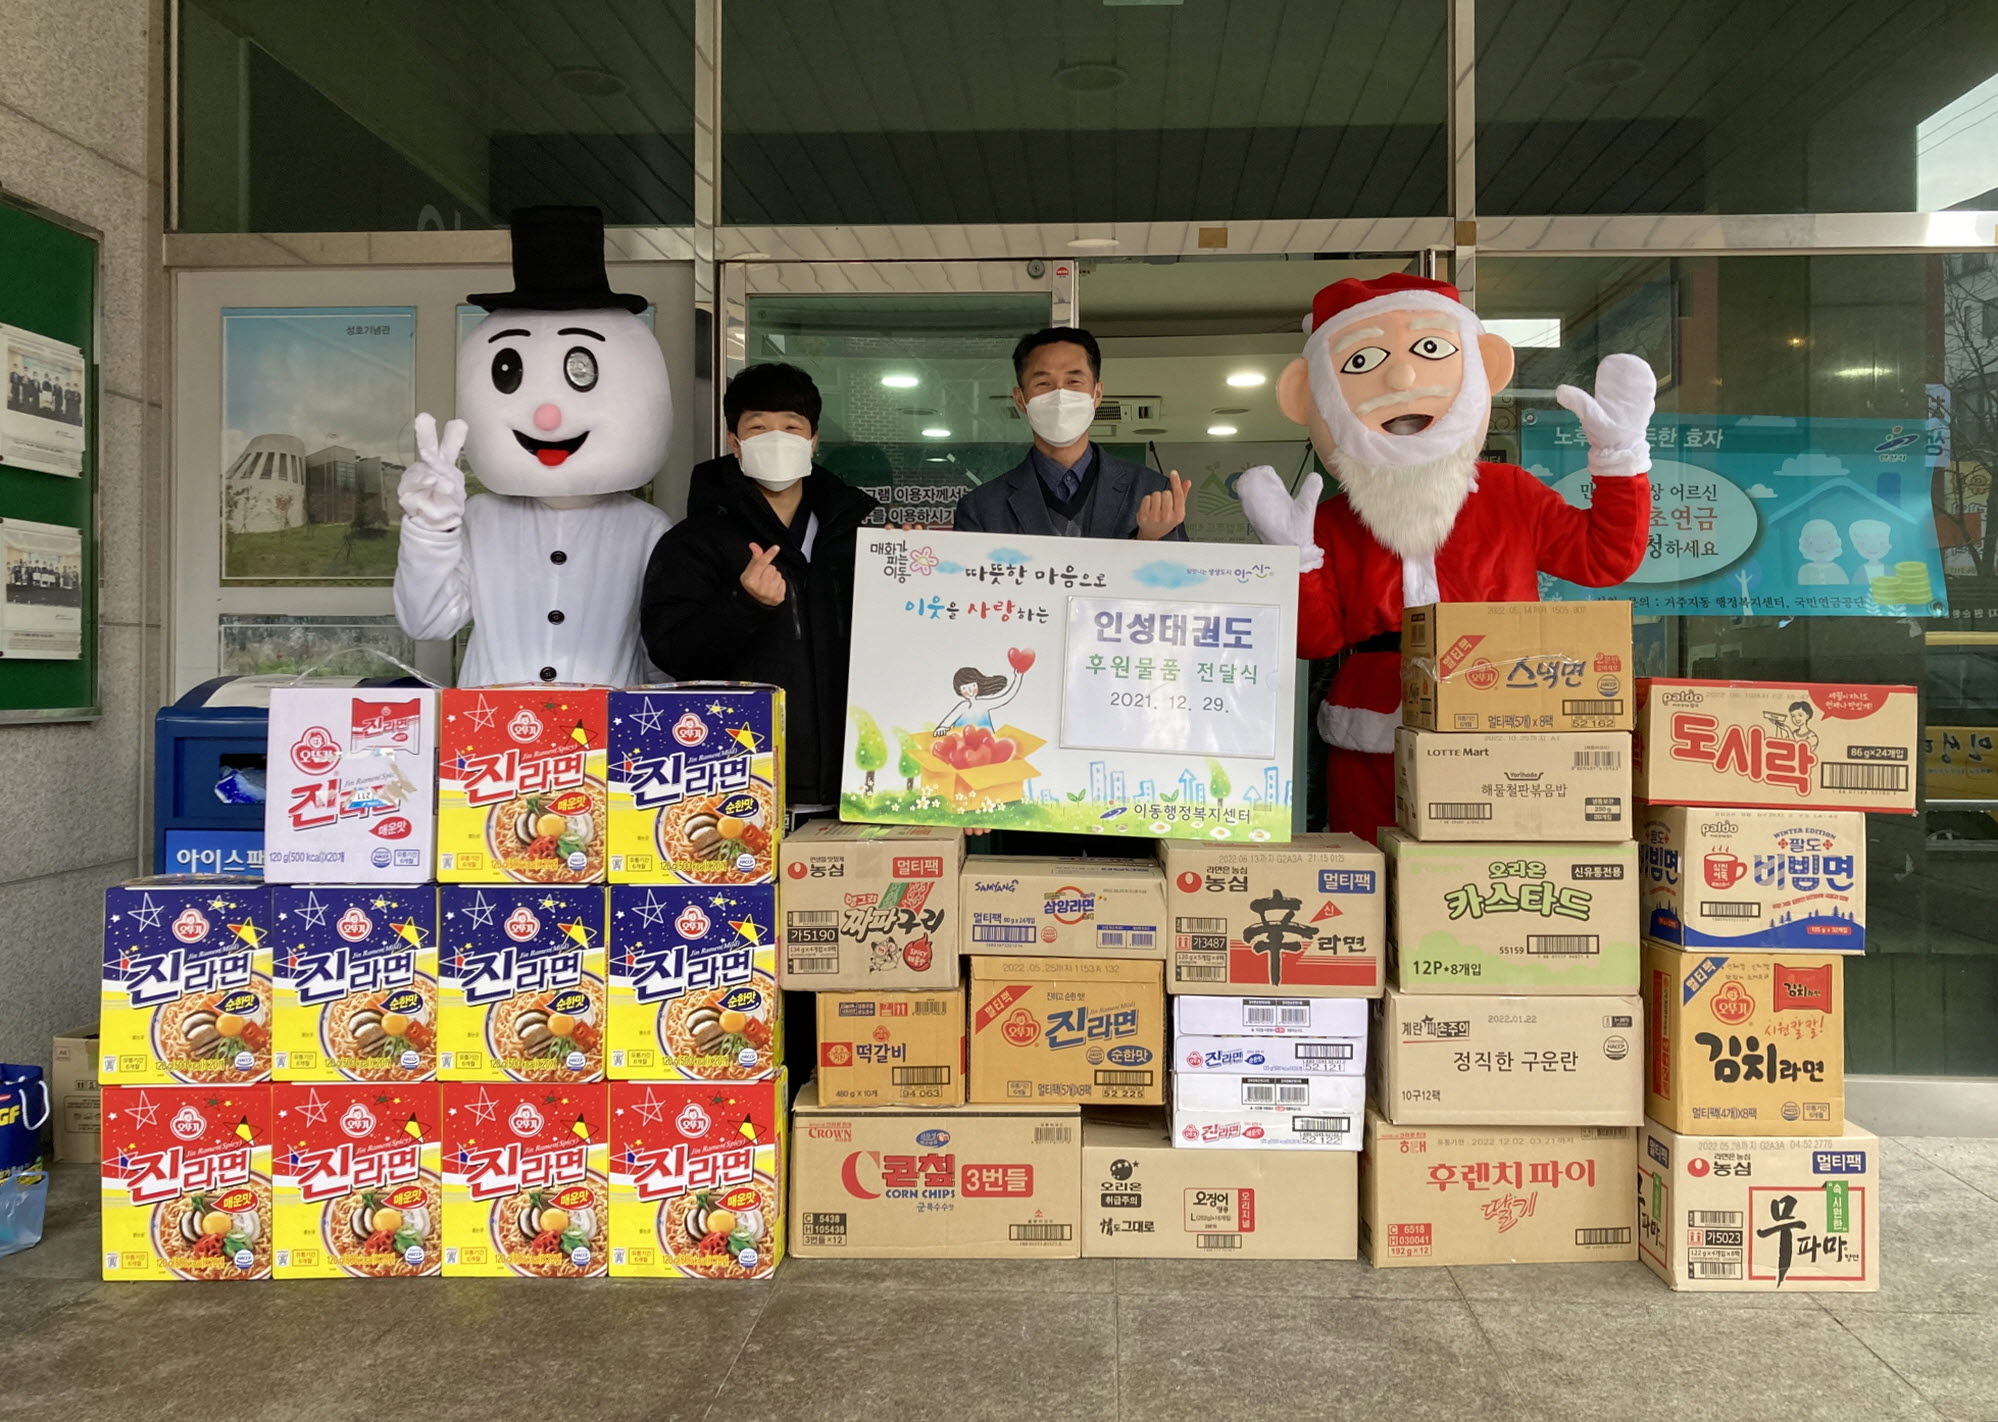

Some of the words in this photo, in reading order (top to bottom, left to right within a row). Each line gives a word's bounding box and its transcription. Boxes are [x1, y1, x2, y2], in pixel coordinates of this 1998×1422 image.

[346, 325, 391, 336] 성호기념관
[1684, 429, 1723, 449] 효자
[1670, 483, 1717, 501] 어르신
[870, 540, 908, 556] 매화가
[883, 566, 911, 583] 이동
[965, 563, 1028, 585] 따뜻한
[1035, 564, 1107, 588] 마음으로
[905, 595, 960, 619] 이웃을
[967, 599, 1049, 624] 사랑하는
[1094, 611, 1253, 649] 인성태권도
[1443, 638, 1472, 668] 멀티팩
[1086, 653, 1181, 682] 후원물품
[1197, 662, 1257, 685] 전달식
[1472, 671, 1494, 683] 오뚜기
[1506, 656, 1586, 689] 스낵면
[1110, 692, 1158, 709] 2021.
[1169, 695, 1192, 711] 12.
[1202, 697, 1229, 713] 29.
[1662, 689, 1703, 706] paldo
[363, 718, 409, 735] 진라면
[513, 725, 538, 734] 오뚜기
[1572, 720, 1587, 728] 52
[1592, 720, 1615, 728] 162
[679, 728, 701, 738] 오뚜기
[1427, 749, 1460, 757] LOTTE
[1462, 748, 1489, 757] Mart
[1671, 712, 1818, 796] 도시락
[465, 749, 584, 805] 진라면
[630, 752, 749, 808] 진라면
[1481, 784, 1567, 797] 해물철판볶음밥
[556, 796, 587, 811] 매운맛
[725, 799, 754, 814] 순한맛
[1134, 804, 1250, 824] 이동행정복지센터
[377, 821, 407, 836] 매운맛
[1701, 820, 1738, 837] paldo
[1773, 828, 1802, 839] WINTER
[1805, 827, 1836, 839] EDITION
[1789, 839, 1821, 852] 팔도
[810, 863, 844, 878] 농심
[897, 859, 939, 875] 멀티팩
[1207, 866, 1230, 874] 라면은
[1232, 866, 1247, 874] 농심
[1489, 861, 1546, 879] 오리온
[1574, 867, 1621, 878] 신유통전용
[1754, 854, 1853, 891] 비빔면
[975, 879, 1019, 893] SAMYANG
[1205, 876, 1248, 893] 농심
[1324, 873, 1370, 890] 멀티팩
[1044, 899, 1094, 914] 삼양라면
[1444, 881, 1592, 921] 카스타드
[1324, 906, 1334, 916] 신
[180, 924, 202, 934] 오뚜기
[344, 924, 366, 933] 오뚜기
[511, 923, 534, 933] 오뚜기
[682, 922, 705, 932] 오뚜기
[841, 906, 945, 943] 짜파구리
[791, 929, 836, 942] 가5190
[1243, 889, 1319, 986] 辛
[1194, 938, 1225, 950] 가3487
[1318, 935, 1366, 955] 라면
[128, 949, 251, 1007] 진라면
[295, 948, 413, 1006] 진라면
[461, 947, 582, 1006] 진라면
[632, 945, 753, 1005] 진라면
[1685, 961, 1717, 992] 멀티팩
[226, 994, 254, 1010] 순한맛
[390, 994, 418, 1009] 순한맛
[556, 994, 585, 1009] 순한맛
[727, 993, 756, 1008] 순한맛
[984, 991, 1013, 1019] 멀티팩
[1719, 1003, 1747, 1015] 오뚜기
[1488, 1015, 1537, 1023] 2022.01.22
[1008, 1025, 1034, 1037] 오뚜기
[1045, 1006, 1138, 1050] 진라면
[1402, 1022, 1422, 1036] 계란
[1427, 1021, 1469, 1037] 파손주의
[856, 1043, 906, 1063] 떡갈비
[1111, 1049, 1148, 1062] 순한맛
[1205, 1050, 1243, 1068] 진라면
[1695, 1032, 1824, 1083] 김치라면
[1306, 1063, 1320, 1071] 52
[1323, 1063, 1343, 1071] 121
[1454, 1051, 1514, 1072] 정직한
[1521, 1051, 1578, 1072] 구운란
[1104, 1090, 1118, 1098] 52
[1122, 1090, 1144, 1098] 225
[1402, 1090, 1440, 1101] 10구12팩
[177, 1122, 201, 1132] 오뚜기
[347, 1119, 371, 1130] 오뚜기
[515, 1118, 538, 1129] 오뚜기
[681, 1119, 705, 1130] 오뚜기
[808, 1127, 852, 1139] CROWN
[1202, 1123, 1241, 1143] 진라면
[1302, 1136, 1317, 1144] 52
[1320, 1136, 1341, 1144] 122
[882, 1154, 955, 1187] 콘칩
[1713, 1161, 1752, 1176] 농심
[1817, 1155, 1862, 1171] 멀티팩
[127, 1146, 250, 1206] 진라면
[298, 1144, 420, 1205] 진라면
[466, 1144, 588, 1201] 진라면
[633, 1144, 752, 1202] 진라면
[966, 1168, 1028, 1192] 3번들
[1426, 1160, 1595, 1192] 후렌치파이
[886, 1190, 918, 1199] CORN
[922, 1190, 955, 1199] CHIPS
[1101, 1182, 1142, 1191] 오리온
[223, 1193, 252, 1208] 매운맛
[393, 1190, 422, 1205] 매운맛
[560, 1191, 590, 1206] 매운맛
[728, 1192, 755, 1207] 매운맛
[1105, 1196, 1138, 1206] 취급주의
[1193, 1191, 1228, 1207] 오징어
[1241, 1192, 1250, 1228] 오리지널
[1481, 1191, 1538, 1233] 딸기
[1708, 1232, 1741, 1244] 가5023
[1756, 1195, 1847, 1288] 무파마
